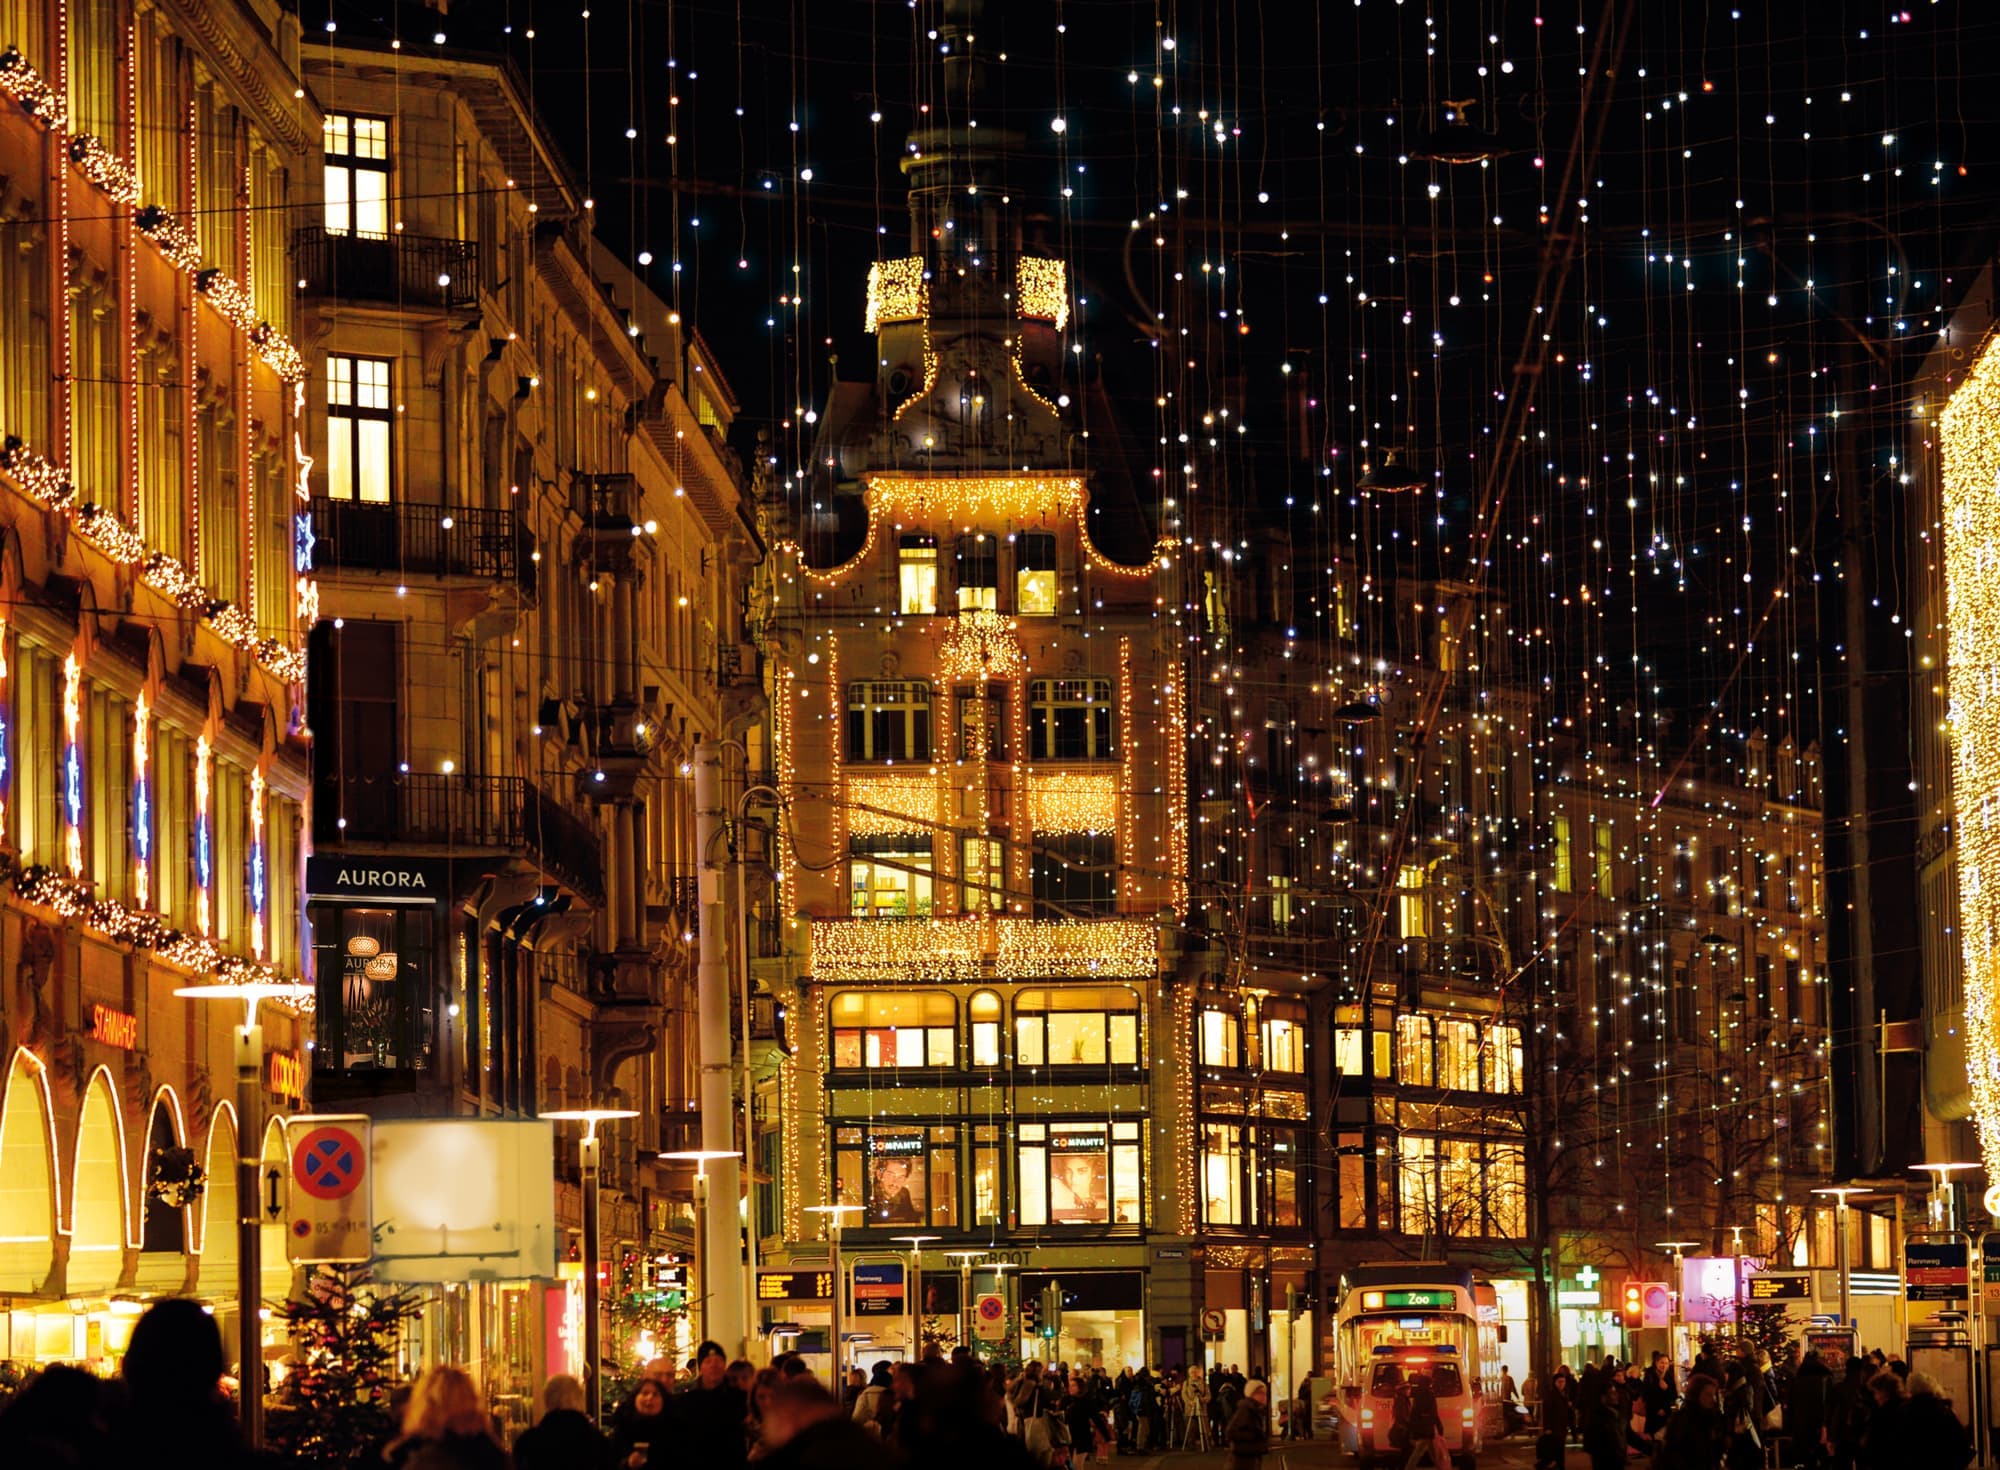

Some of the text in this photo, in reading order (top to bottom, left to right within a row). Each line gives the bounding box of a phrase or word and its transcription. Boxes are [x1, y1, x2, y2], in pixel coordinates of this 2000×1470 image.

[336, 869, 426, 888] AURORA
[869, 1141, 922, 1151] COMPANYS
[1053, 1137, 1105, 1148] COMPANYS
[1408, 1293, 1430, 1305] Zoo
[1915, 1291, 1922, 1300] 7
[861, 1302, 867, 1310] 7
